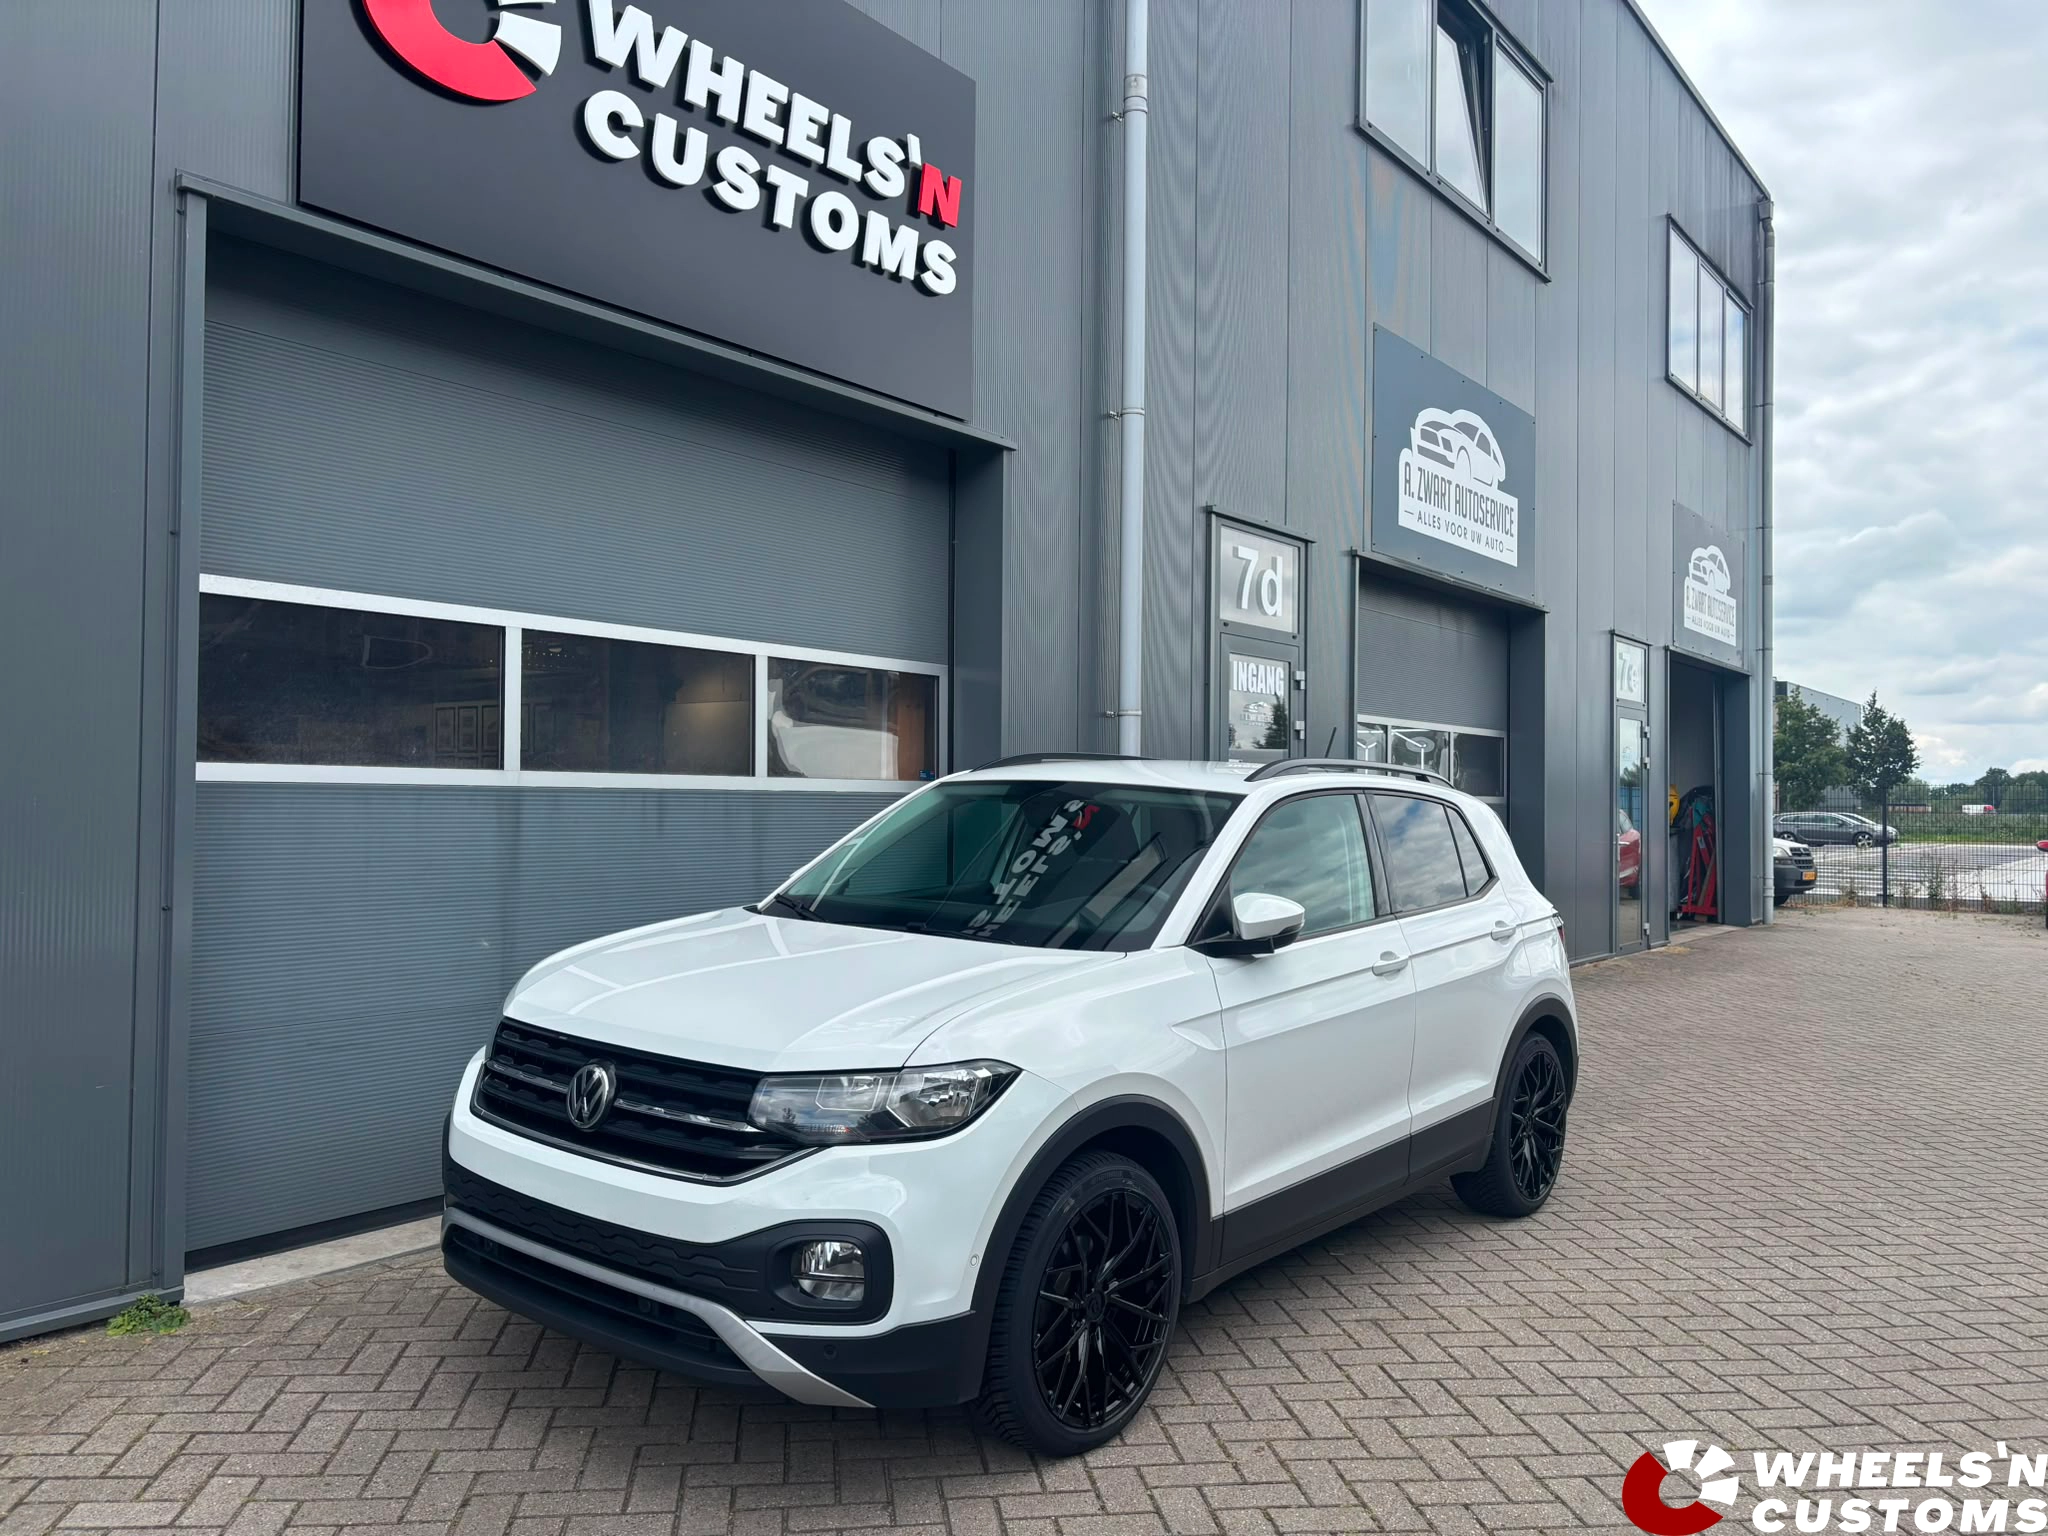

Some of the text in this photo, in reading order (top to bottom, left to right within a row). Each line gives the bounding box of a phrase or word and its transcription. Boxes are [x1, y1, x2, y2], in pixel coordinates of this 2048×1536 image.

[584, 90, 957, 295] CUSTOMS
[1404, 461, 1514, 538] A. ZWART AUTOSERVICE
[1417, 510, 1504, 553] ALLES VOOR UW AUTO
[1236, 545, 1283, 617] 7d
[1233, 660, 1284, 697] INGANG
